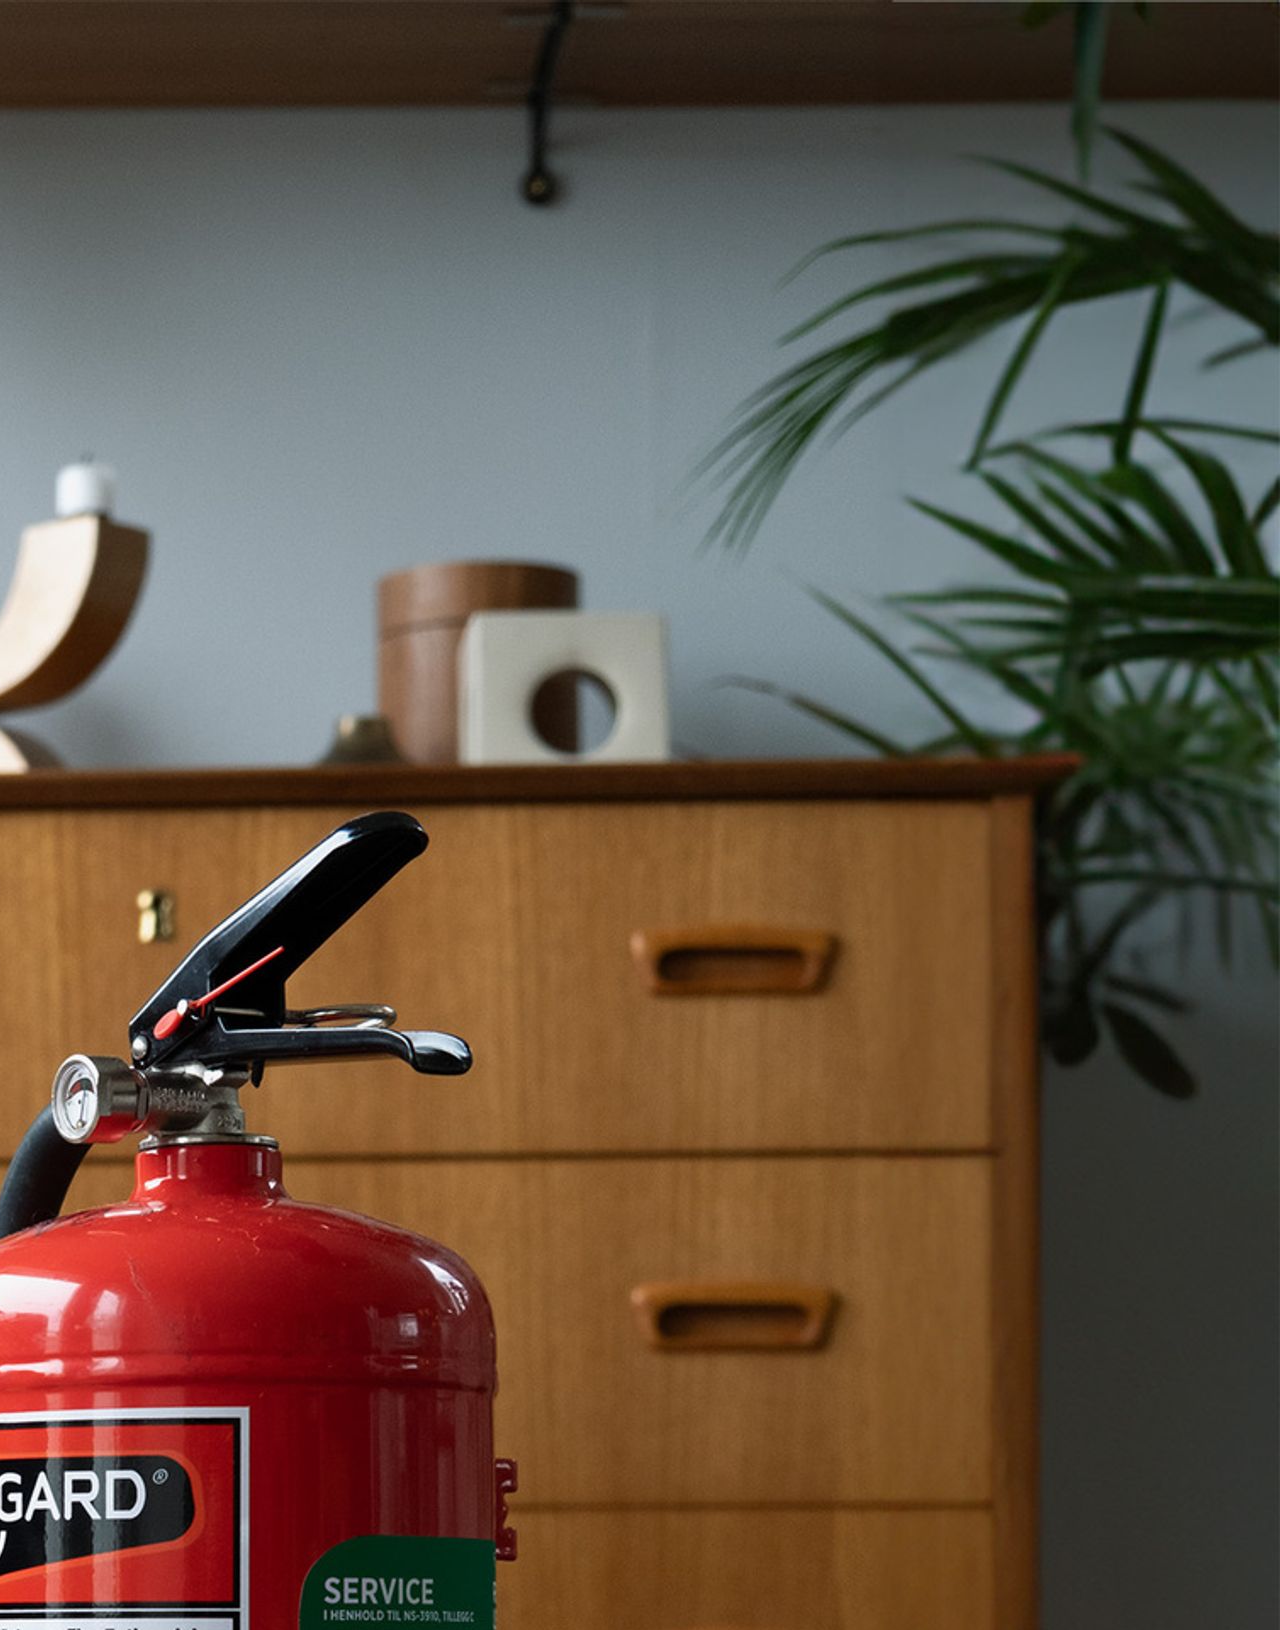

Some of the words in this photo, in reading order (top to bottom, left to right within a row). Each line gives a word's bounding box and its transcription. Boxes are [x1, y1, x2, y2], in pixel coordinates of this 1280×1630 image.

[324, 1577, 434, 1605] SERVICE
[323, 1610, 327, 1621] I
[330, 1610, 385, 1621] HENHOLD
[387, 1610, 401, 1621] TIL
